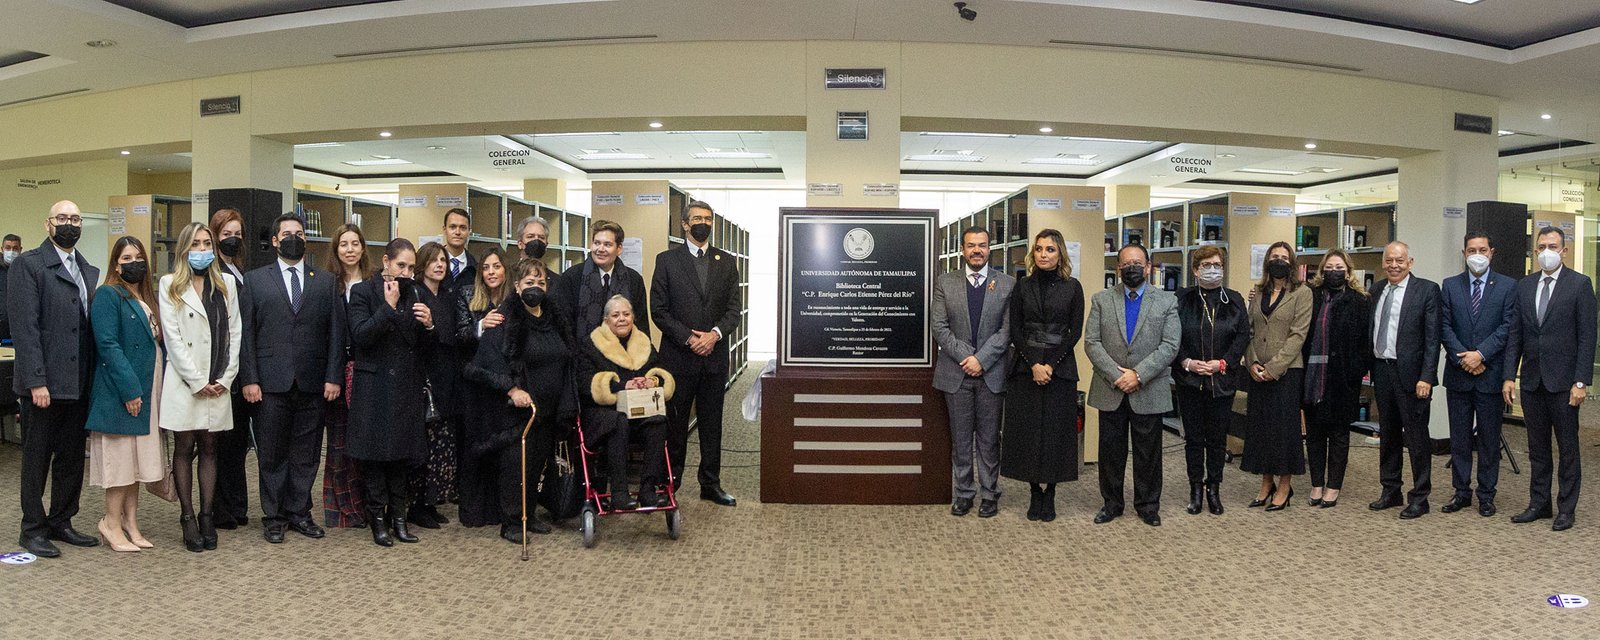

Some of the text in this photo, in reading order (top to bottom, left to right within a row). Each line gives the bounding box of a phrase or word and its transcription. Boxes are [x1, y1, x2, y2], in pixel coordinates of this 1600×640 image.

[837, 74, 874, 83] Silencio
[1175, 165, 1207, 174] GENERAL
[818, 290, 839, 298] Enrique
